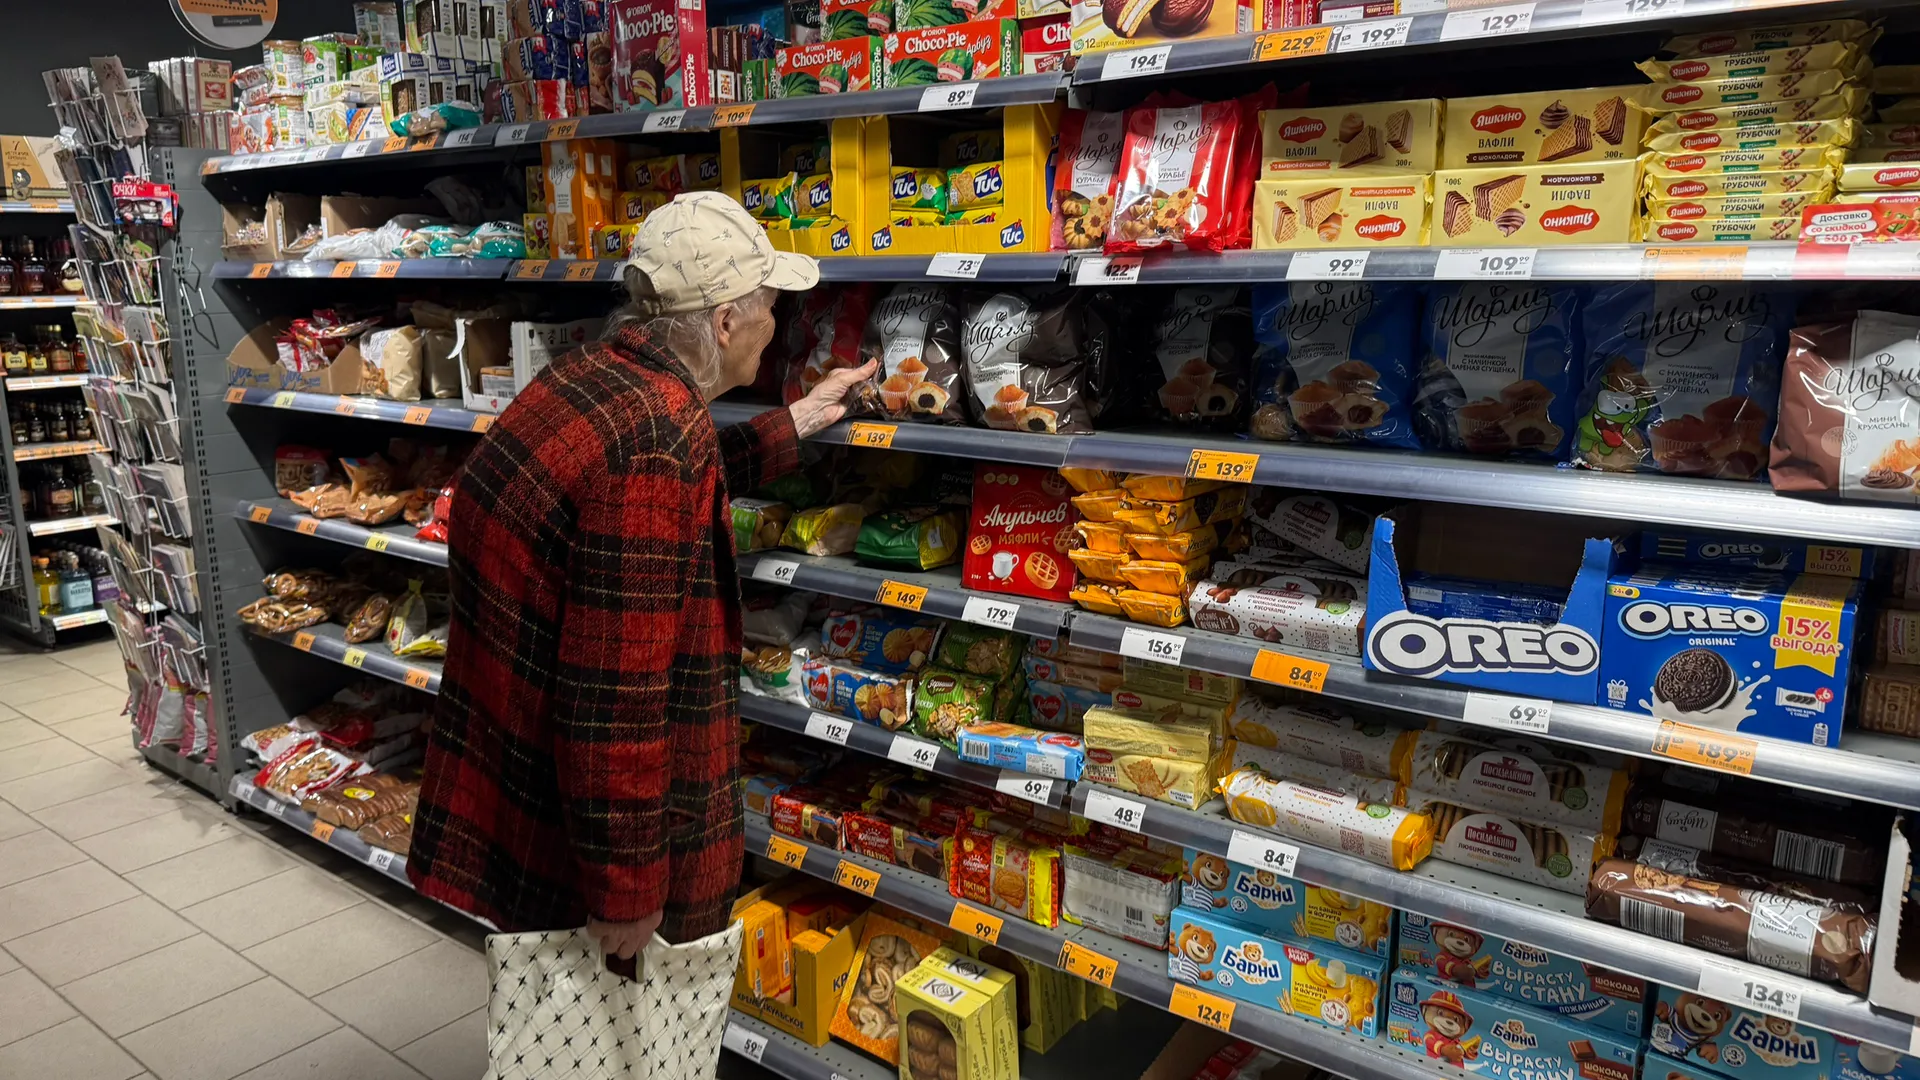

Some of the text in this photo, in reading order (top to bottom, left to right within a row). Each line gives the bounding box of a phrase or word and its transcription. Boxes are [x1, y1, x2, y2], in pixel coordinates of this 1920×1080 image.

[1482, 15, 1518, 31] 129
[1361, 27, 1396, 44] 199
[1750, 31, 1793, 41] ТРУБОЧКИ
[966, 35, 993, 57] Арбуз
[1084, 38, 1096, 49] 12
[1280, 36, 1315, 52] 229
[1130, 54, 1158, 69] 194
[1724, 56, 1771, 67] ТРУБОЧКИ
[1672, 65, 1707, 77] Яшкино
[1717, 81, 1764, 93] ТРУБОЧКИ
[947, 90, 966, 103] 89
[1665, 89, 1701, 101] Яшкино
[727, 112, 744, 123] 109
[1475, 111, 1522, 128] Яшкино
[1731, 107, 1778, 118] ТРУБОЧКИ
[658, 116, 677, 127] 249
[1681, 115, 1715, 126] Яшкино
[557, 126, 572, 135] 199
[1283, 123, 1323, 138] Яшкино
[1736, 128, 1781, 139] ТРУБОЧКИ
[1478, 137, 1515, 149] ВАФЛИ
[1684, 136, 1719, 148] Яшкино
[1285, 146, 1317, 158] ВАФЛИ
[1477, 153, 1519, 161] ШОКОЛАДОМ
[1719, 154, 1765, 162] ТРУБОЧКИ
[1668, 157, 1704, 169] Яшкино
[700, 163, 718, 178] TUC
[1878, 170, 1919, 182] Яшкино
[893, 177, 917, 197] TUC
[974, 176, 1000, 195] TUC
[1546, 176, 1592, 184] ШОКОЛАДОМ
[1721, 180, 1767, 189] ТРУБОЧКИ
[113, 184, 136, 196] ОЧКИ
[809, 188, 831, 205] TUC
[1551, 189, 1591, 201] ВАФЛИ
[1670, 185, 1705, 196] Яшкино
[744, 190, 762, 208] TUC
[1364, 200, 1399, 211] ВАФЛИ
[626, 204, 643, 218] TUC
[1670, 207, 1704, 218] Яшкино
[1720, 203, 1765, 212] ТРУБОЧКИ
[1543, 212, 1595, 228] Яшкино
[1819, 211, 1868, 223] Доставка
[1358, 220, 1402, 236] Яшкино
[1661, 226, 1695, 237] Яшкино
[1711, 224, 1756, 232] ТРУБОЧКИ
[1824, 223, 1867, 233] скидкой
[605, 236, 621, 251] TUC
[831, 234, 850, 248] TUC
[871, 234, 891, 249] TUC
[1001, 228, 1024, 245] TUC
[1824, 234, 1848, 243] 500
[957, 260, 973, 272] 73
[1105, 264, 1128, 277] 122
[1329, 259, 1354, 273] 99
[1479, 256, 1519, 271] 109
[1431, 287, 1557, 348] Шармиз
[1451, 364, 1483, 372] ВАРЕНАЯ
[1469, 358, 1508, 367] НАЧИНКОЙ
[1666, 369, 1720, 381] НАЧИНКОЙ
[1665, 378, 1707, 387] ВАРЕНАЯ
[1857, 421, 1910, 431] КРУАССАНЫ
[1869, 415, 1897, 423] МИНИ
[865, 431, 886, 444] 139
[1216, 461, 1244, 477] 139
[979, 502, 1068, 533] Акульчев
[998, 533, 1040, 545] МЯФЛИ
[1700, 543, 1764, 558] OREO
[1818, 548, 1849, 564] 15%
[774, 566, 789, 578] 69
[1809, 562, 1853, 573] ВЫГОДА
[896, 590, 916, 604] 149
[987, 606, 1008, 621] 179
[1625, 602, 1767, 633] OREO
[1784, 615, 1833, 640] 15%
[1147, 638, 1173, 656] 156
[1375, 621, 1597, 673] OREO
[1289, 666, 1313, 684] 84
[1509, 705, 1537, 722] 69
[826, 723, 841, 738] 112
[913, 749, 930, 762] 46
[1698, 741, 1739, 763] 189
[1024, 780, 1043, 795] 69
[1114, 807, 1134, 822] 48
[784, 851, 796, 864] 59
[1263, 849, 1286, 866] 84
[851, 875, 870, 890] 109
[1236, 877, 1296, 903] Барни
[975, 923, 992, 937] 99
[1503, 942, 1548, 965] Барни
[1223, 949, 1282, 980] Барни
[1088, 963, 1105, 981] 74
[1492, 961, 1574, 986] ВЫРАСТУ
[1519, 982, 1586, 1002] СТАНУ
[1744, 981, 1784, 1005] 134
[1558, 998, 1607, 1014] ПОЖАРНЫМ
[1196, 1004, 1221, 1024] 124
[1492, 1025, 1537, 1048] Барни
[1736, 1019, 1817, 1061] Барни
[743, 1039, 758, 1052] 59
[1480, 1041, 1563, 1068] ВЫРАСТУ
[1508, 1064, 1574, 1080] СТАНУ
